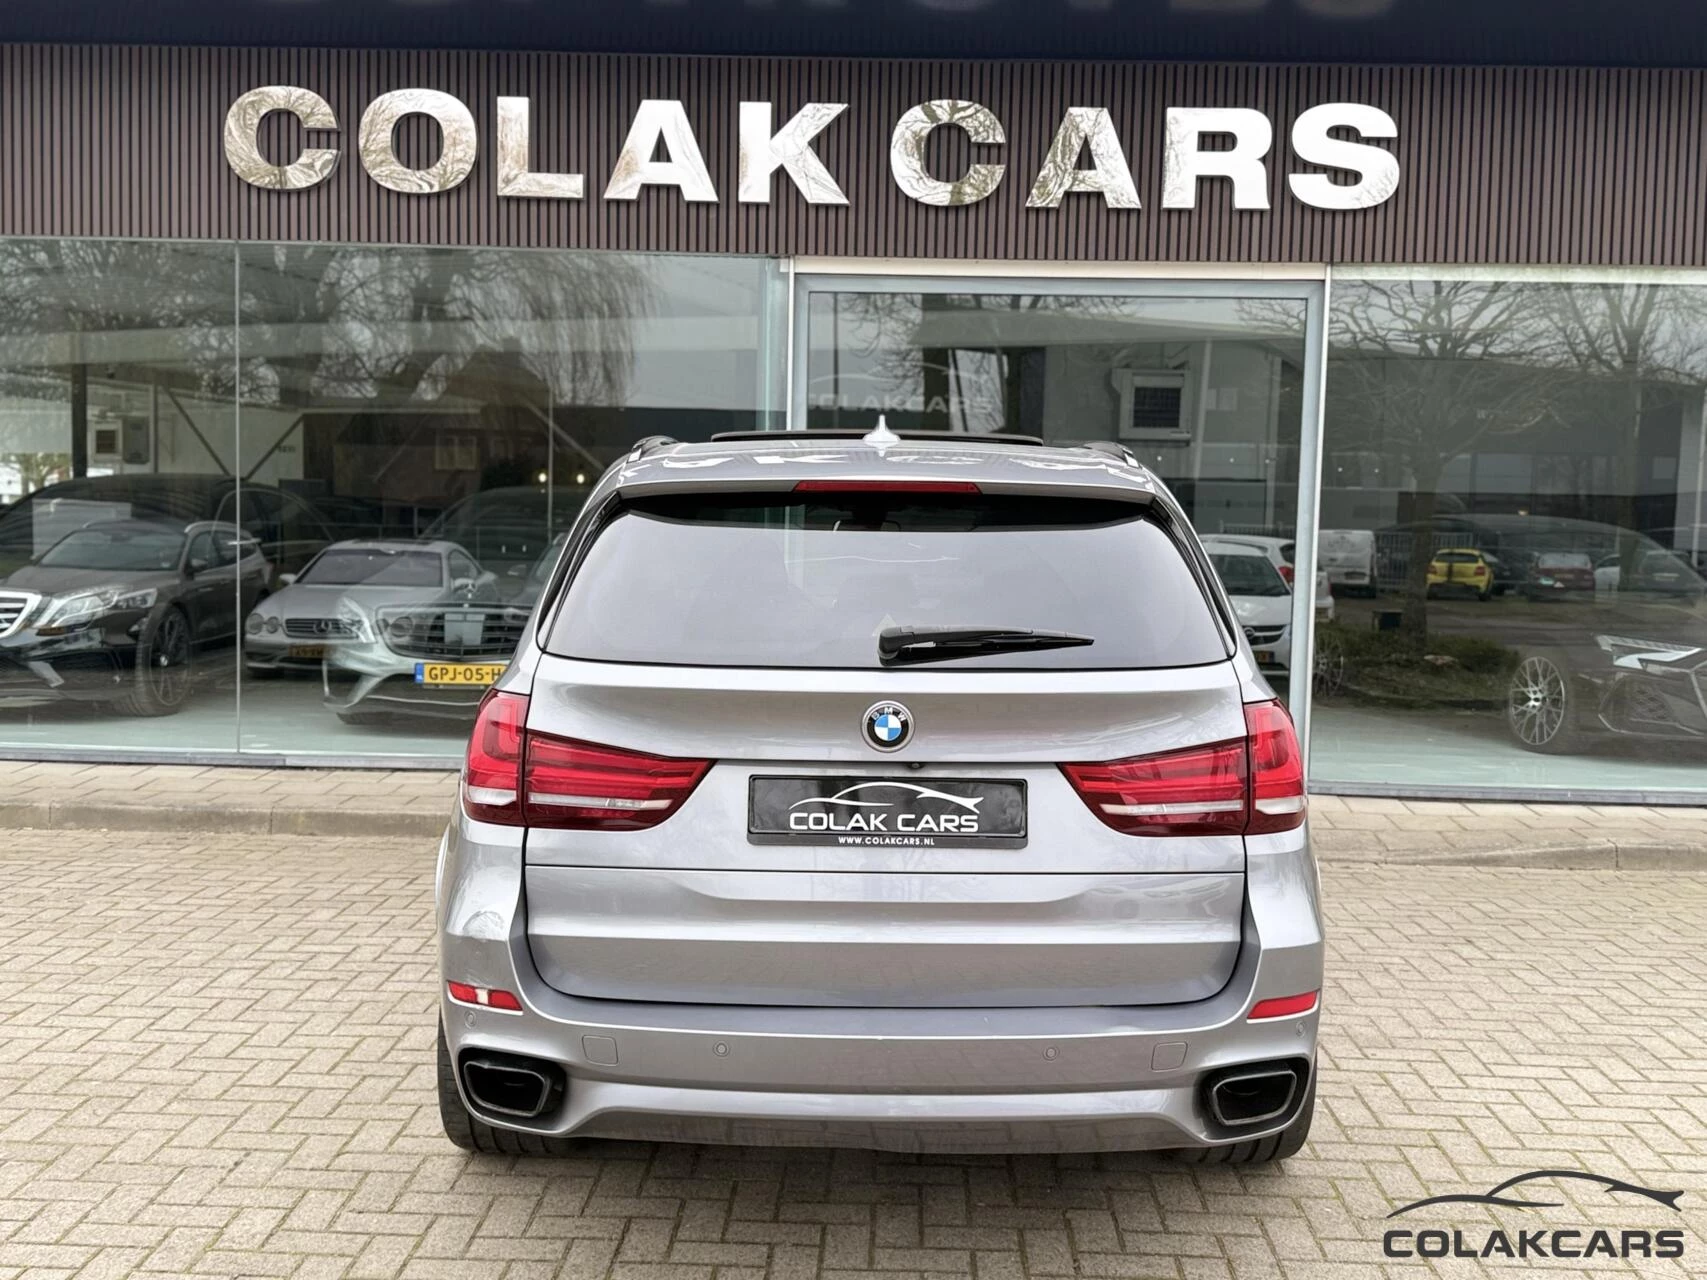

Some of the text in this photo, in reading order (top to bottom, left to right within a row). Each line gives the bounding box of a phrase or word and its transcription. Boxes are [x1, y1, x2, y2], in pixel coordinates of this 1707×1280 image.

[223, 85, 1400, 211] COLAK CARS
[428, 666, 501, 681] GPJ-05-H
[871, 706, 907, 722] BMW
[789, 812, 979, 833] COLAK CARS
[838, 836, 935, 846] WWW.COLAKCARS.NL
